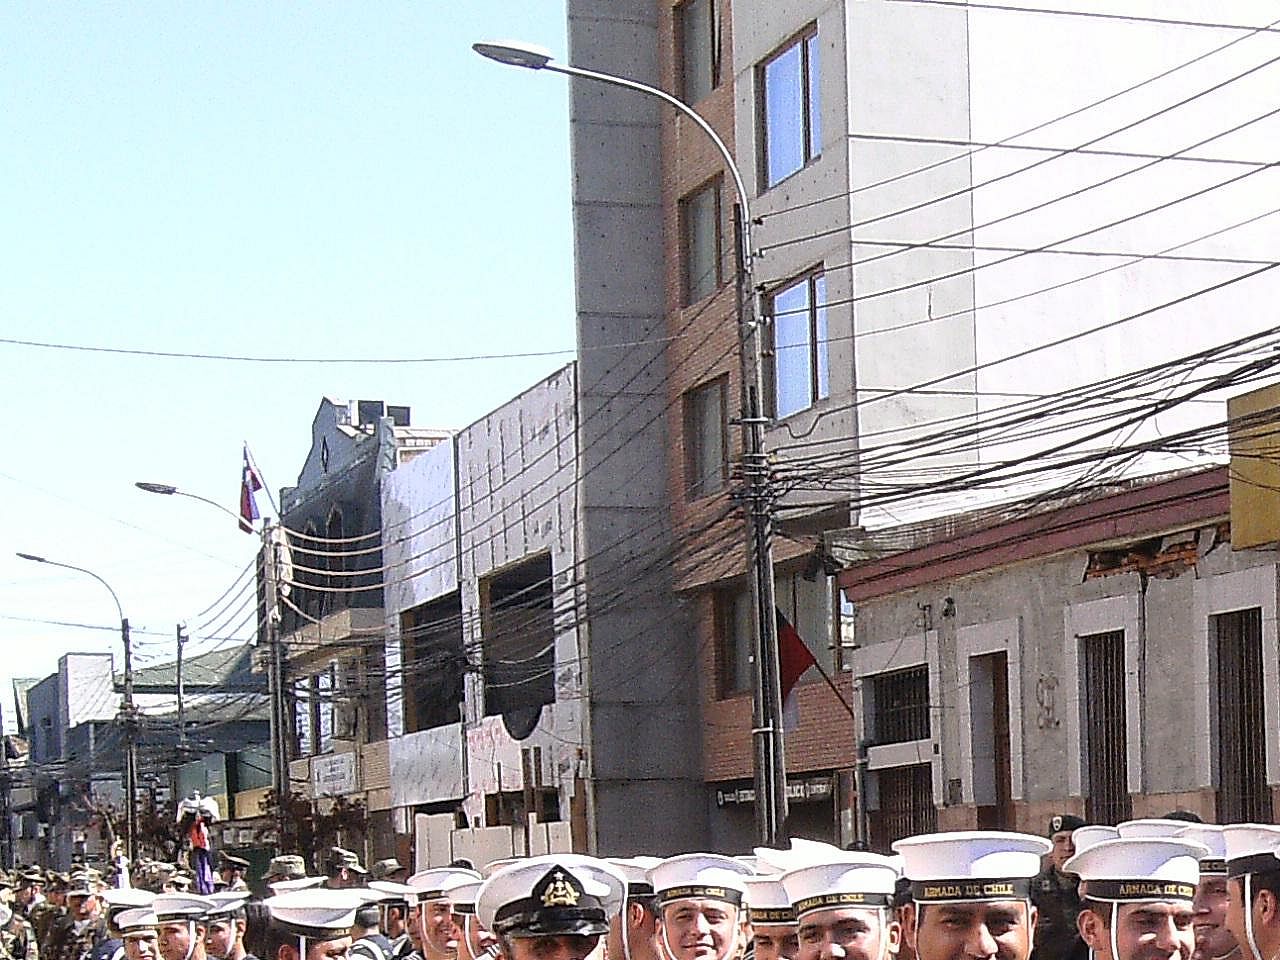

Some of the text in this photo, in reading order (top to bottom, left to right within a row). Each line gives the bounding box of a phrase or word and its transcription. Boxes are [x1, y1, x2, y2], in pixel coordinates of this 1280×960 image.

[924, 883, 1015, 897] ARMADA DE CHILE
[1119, 884, 1161, 896] ARMADA
